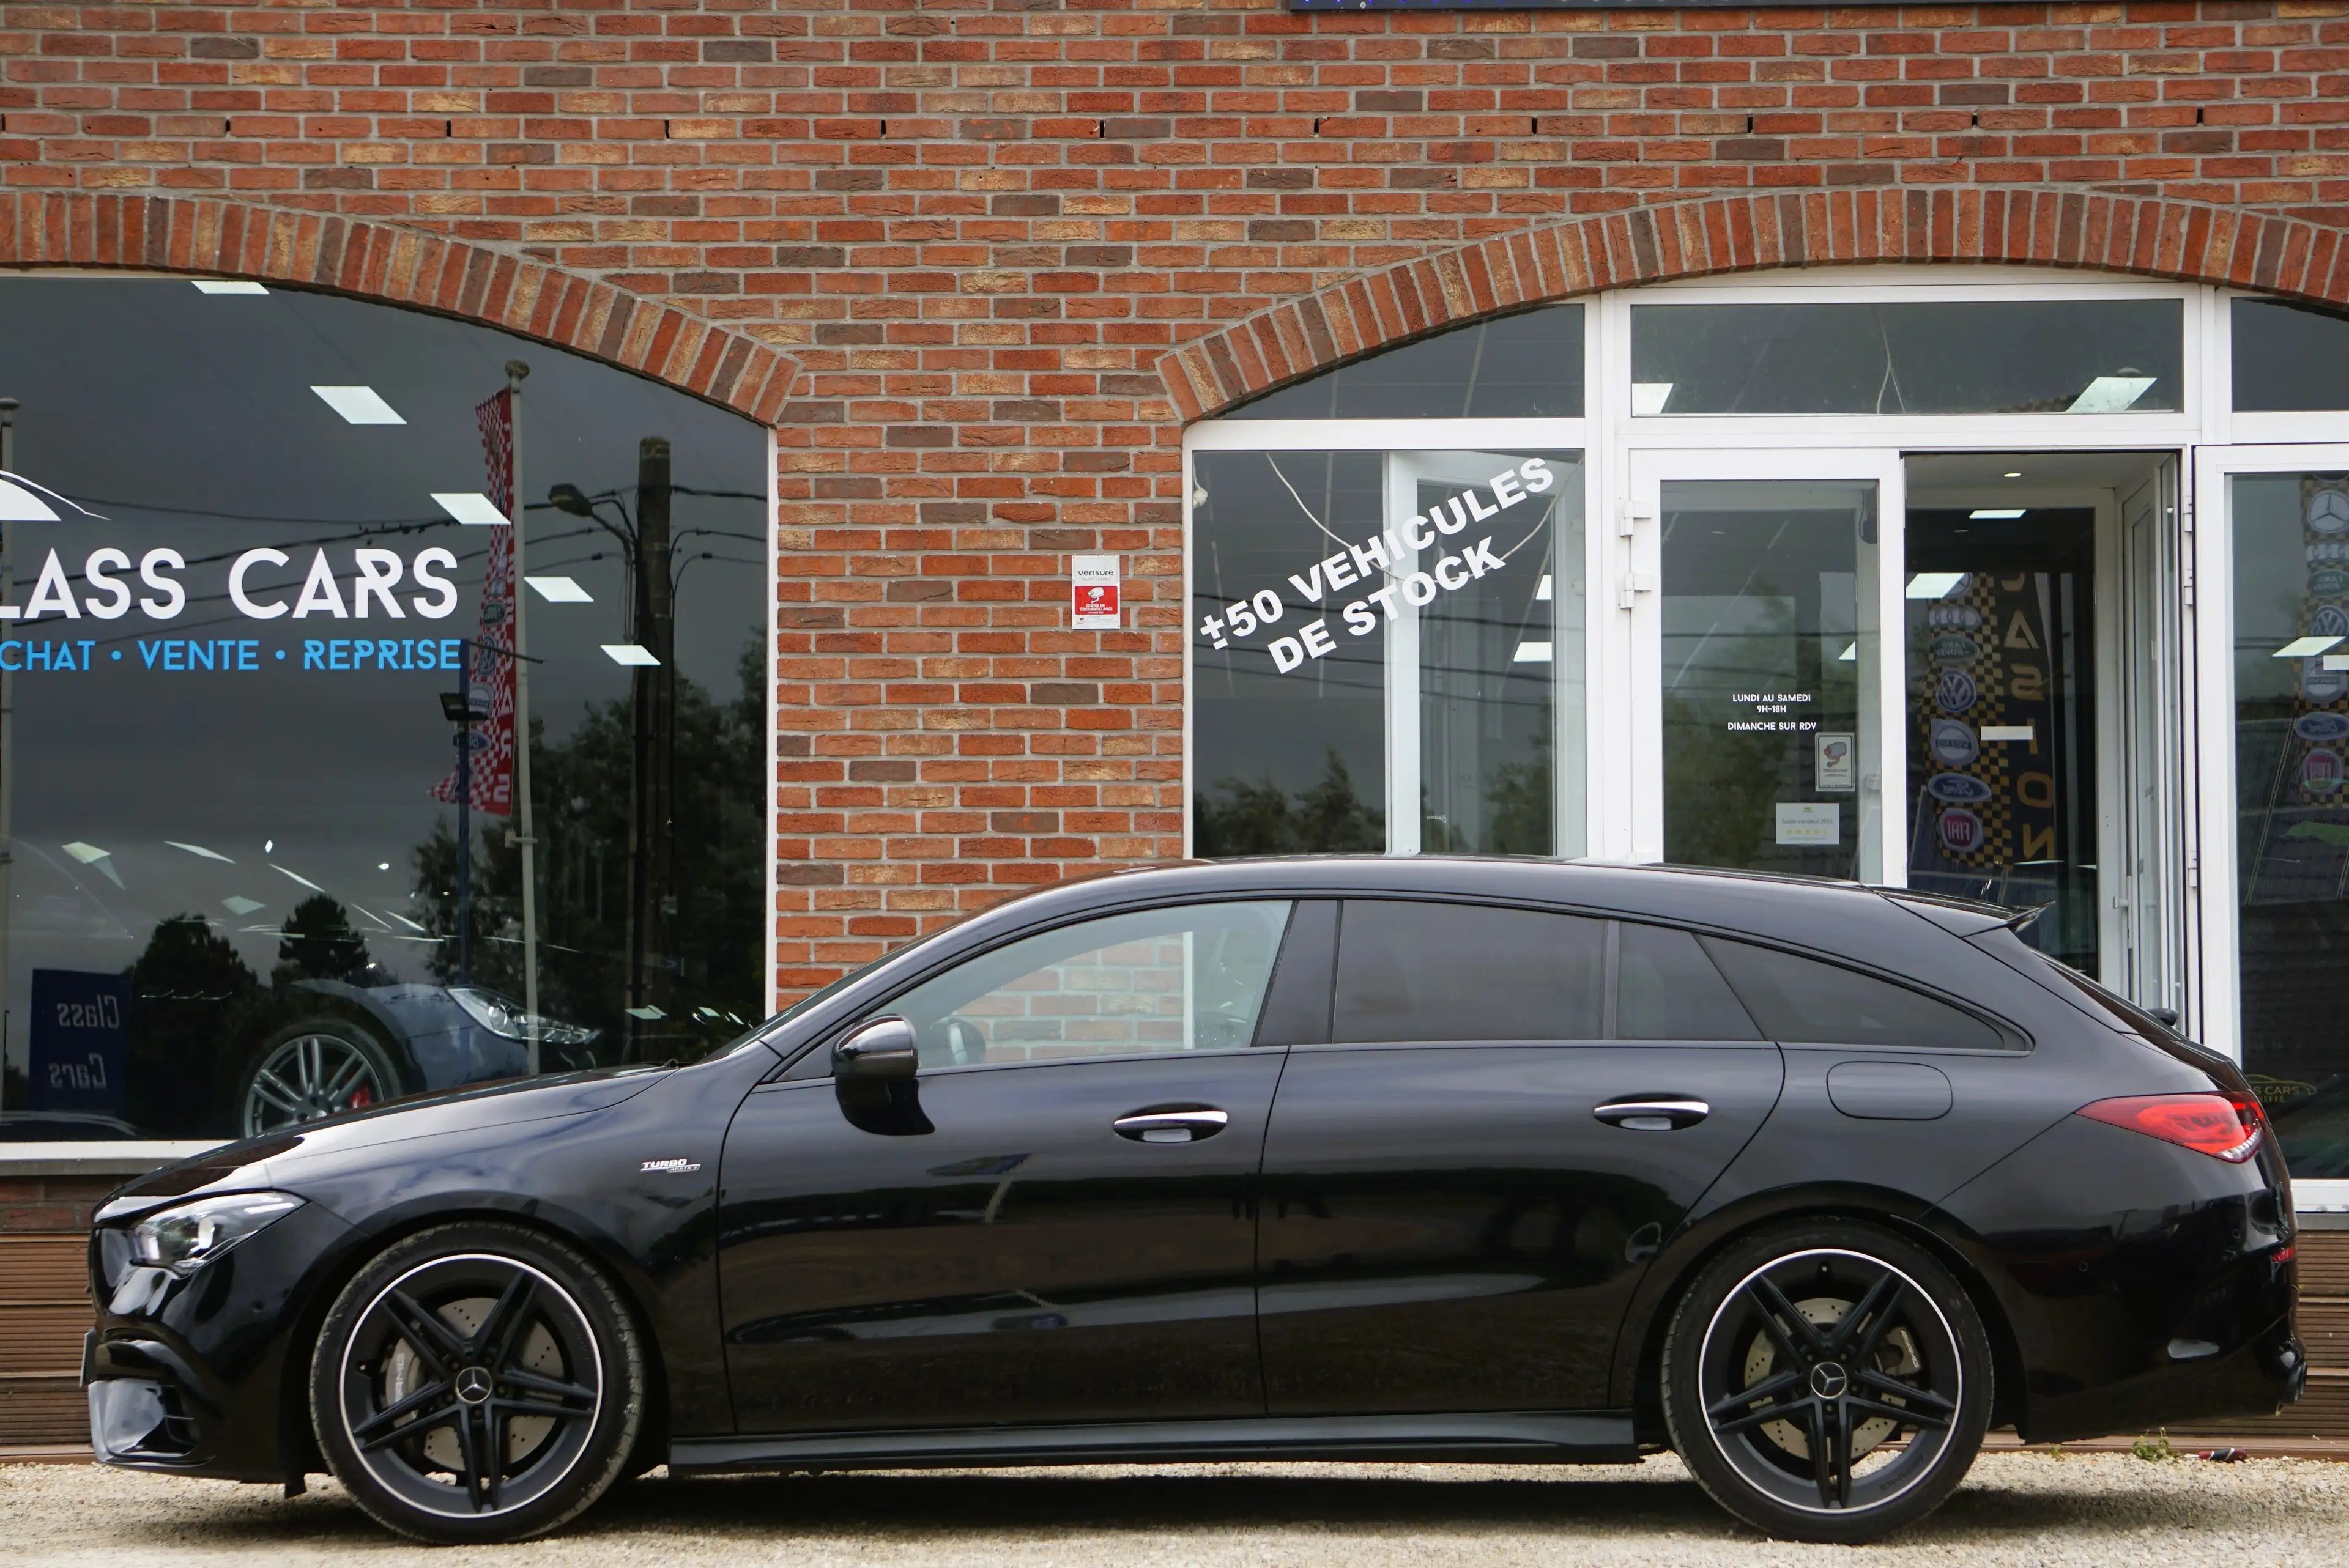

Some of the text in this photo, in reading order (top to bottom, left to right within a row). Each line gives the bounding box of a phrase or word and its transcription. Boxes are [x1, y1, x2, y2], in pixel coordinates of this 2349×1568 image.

[1288, 457, 1553, 602] VEHICULES
[229, 548, 458, 619] CARS
[1267, 536, 1507, 674] DE STOCK
[138, 640, 259, 670] VENTE
[304, 639, 461, 670] REPRISE
[1732, 693, 1811, 702] LUNDI AU SAMEDI
[1757, 704, 1786, 713] 9H-18H
[1727, 722, 1817, 730] DIMANCHE SUR RDV
[2264, 1085, 2300, 1095] CARS
[641, 1159, 688, 1168] TURBO
